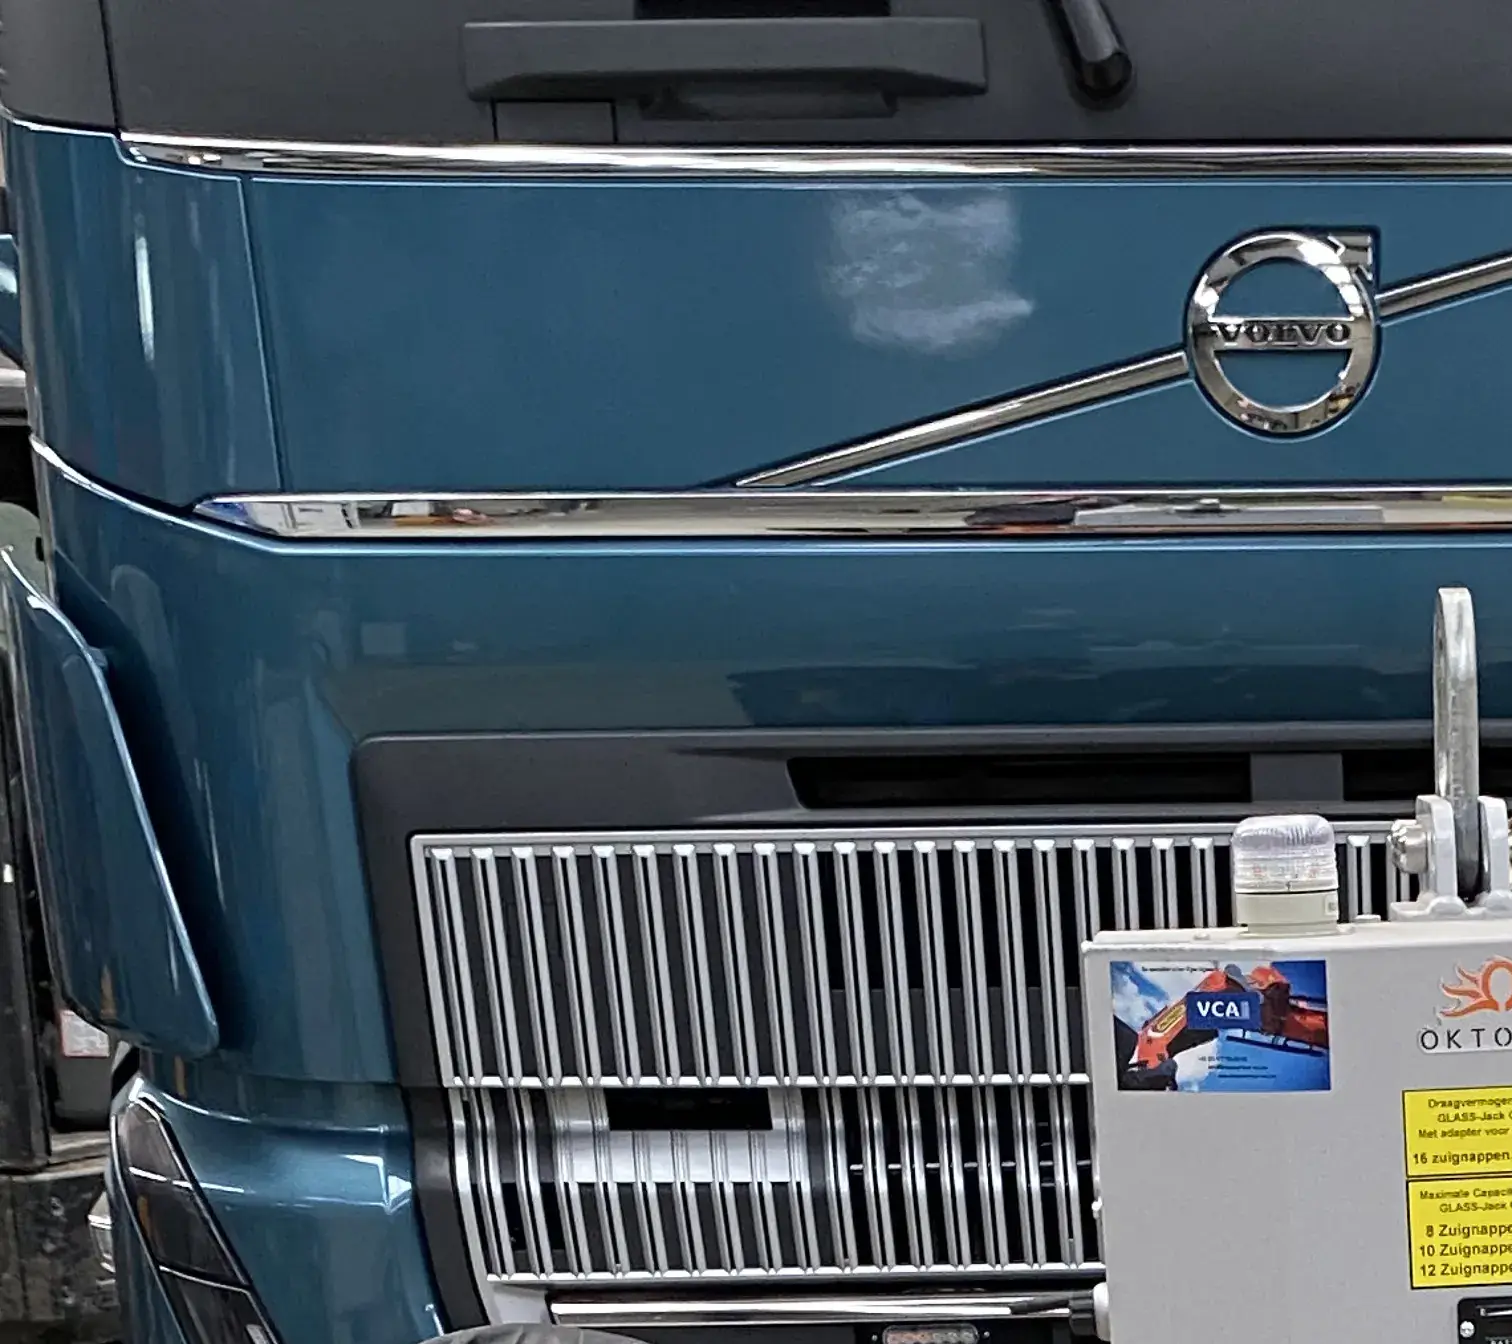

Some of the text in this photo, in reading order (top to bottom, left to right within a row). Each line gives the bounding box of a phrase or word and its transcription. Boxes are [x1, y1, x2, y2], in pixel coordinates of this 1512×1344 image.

[1211, 323, 1350, 346] VOLVO
[1418, 1128, 1438, 1139] Met
[1413, 1153, 1428, 1165] 16
[1425, 1225, 1435, 1238] 8
[1419, 1244, 1435, 1257] 10
[1419, 1264, 1436, 1277] 12
